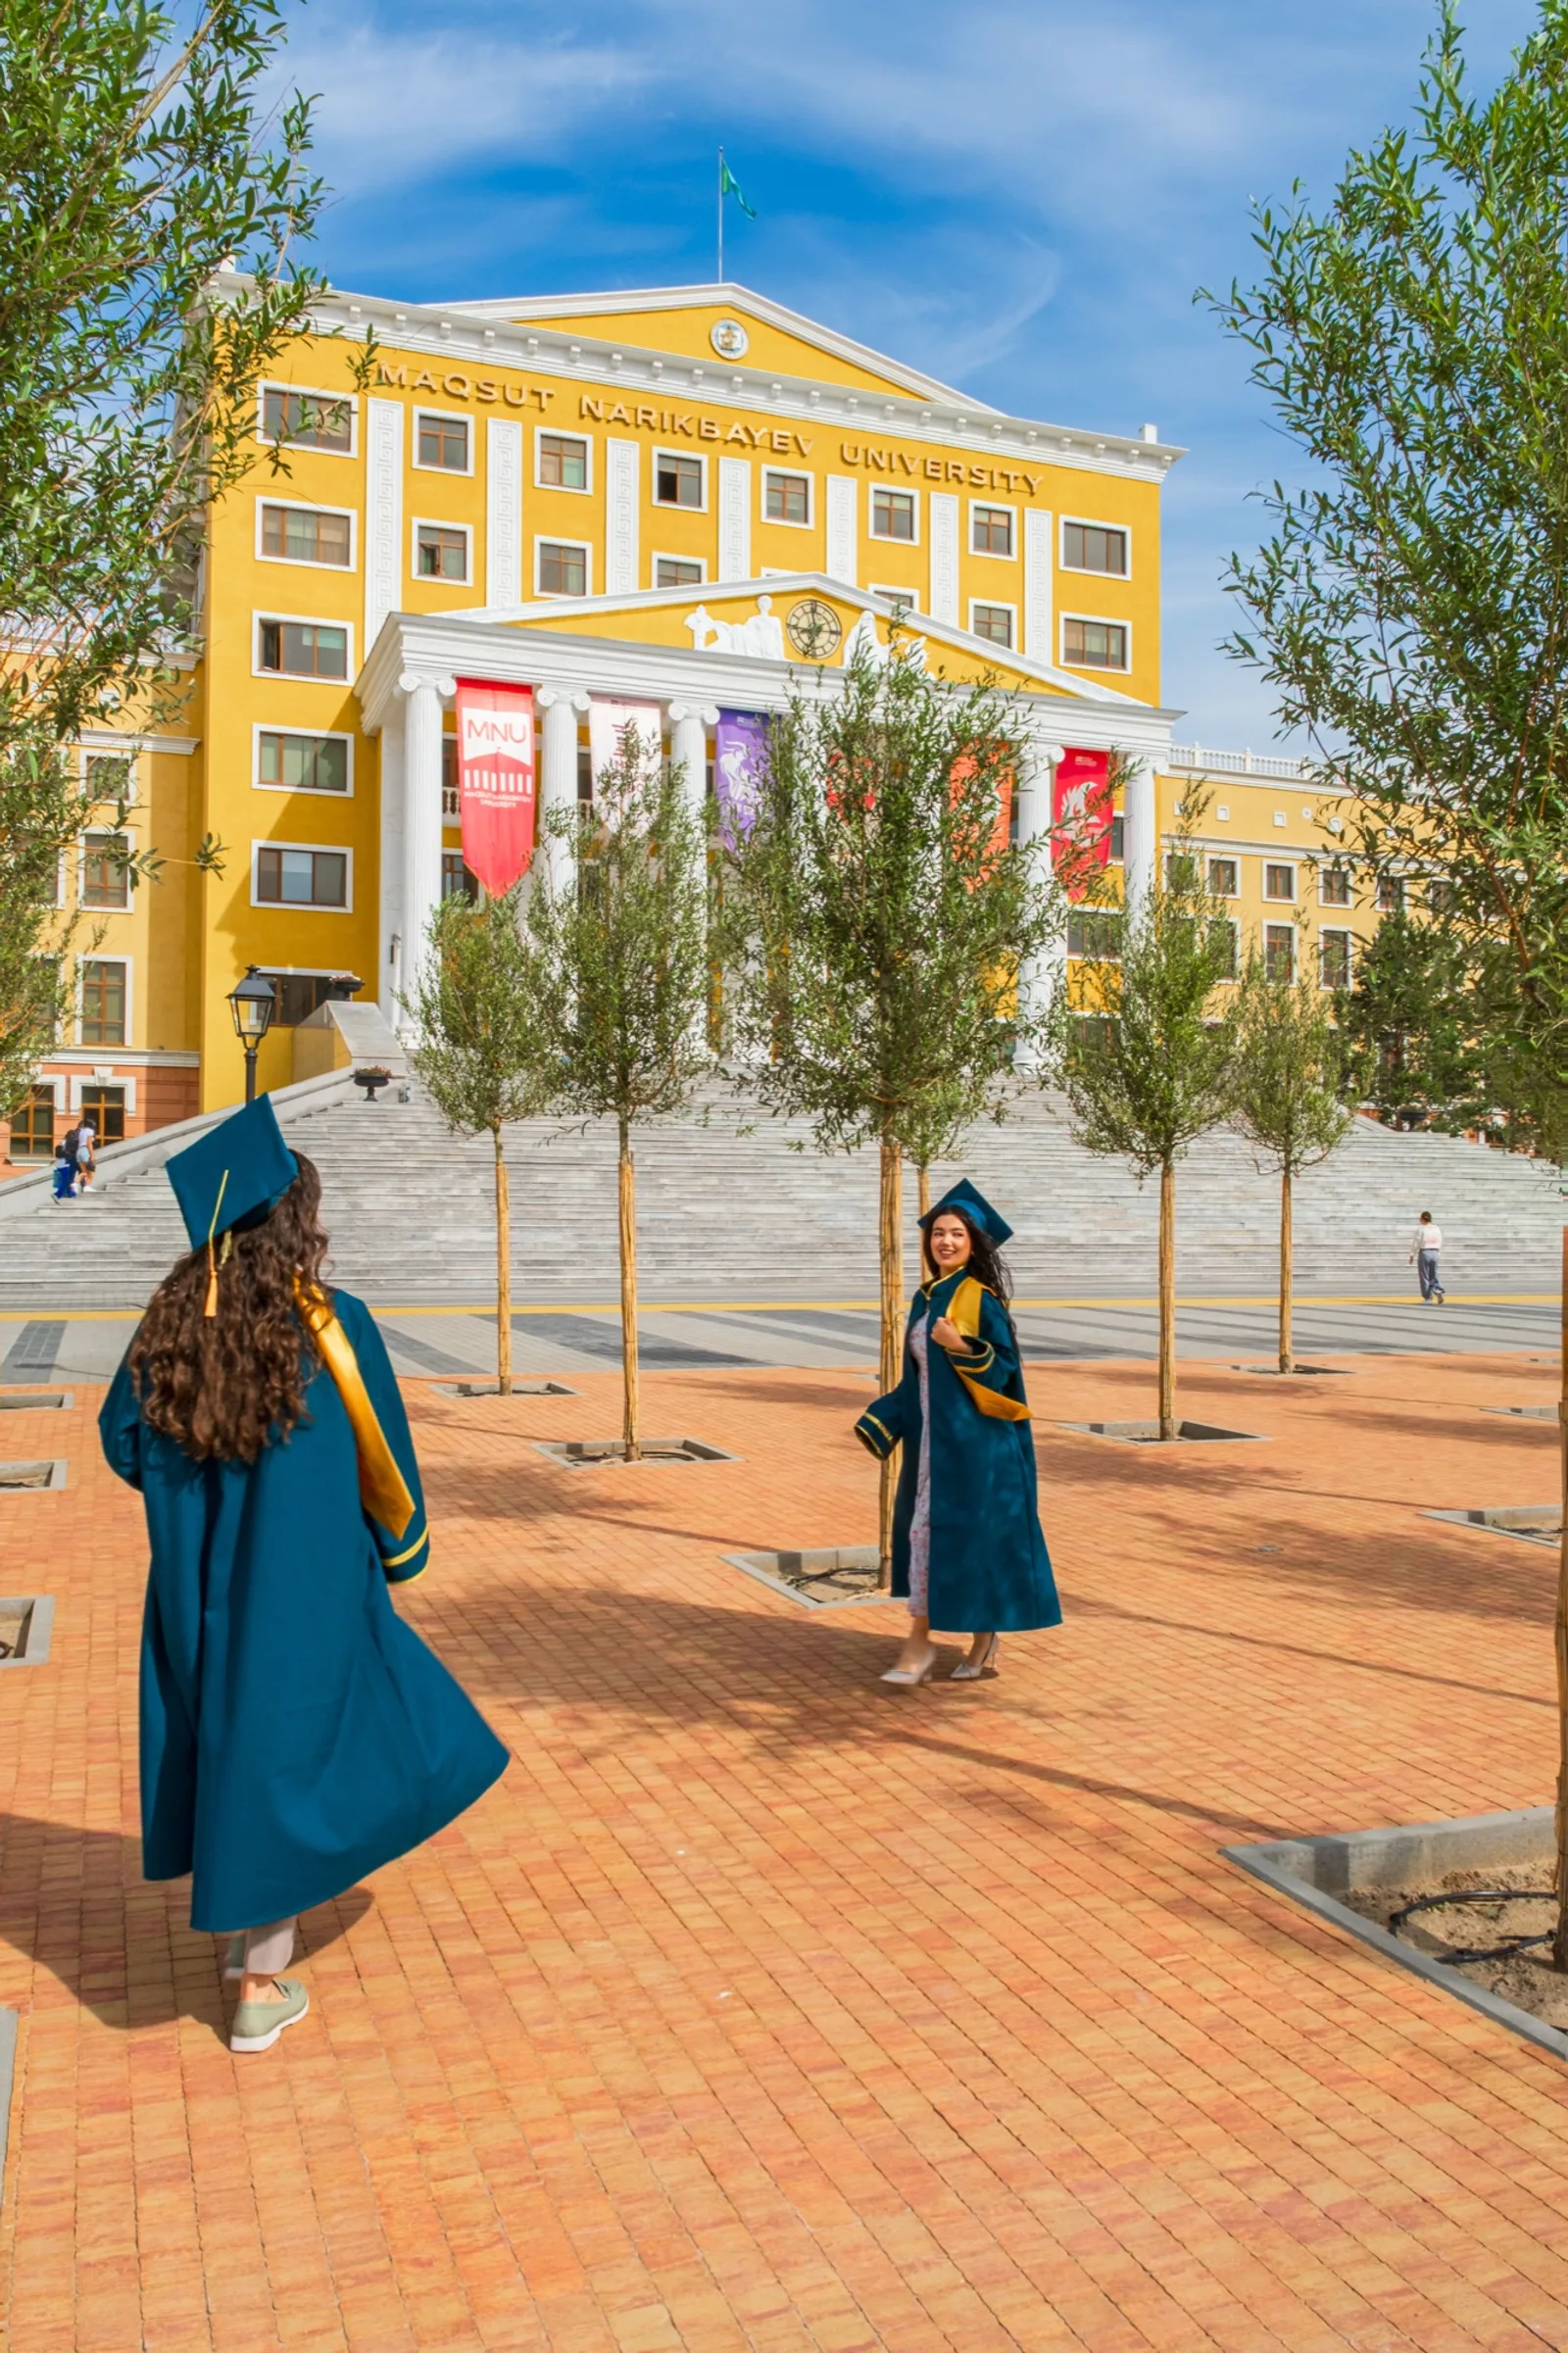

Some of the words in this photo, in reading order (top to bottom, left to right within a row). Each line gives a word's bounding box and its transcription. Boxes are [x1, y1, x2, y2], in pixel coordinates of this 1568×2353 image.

[378, 360, 557, 412] MAQSUT
[579, 394, 814, 457] NARIKBAYEV
[841, 442, 1044, 496] UNIVERSITY
[467, 718, 527, 744] MNU
